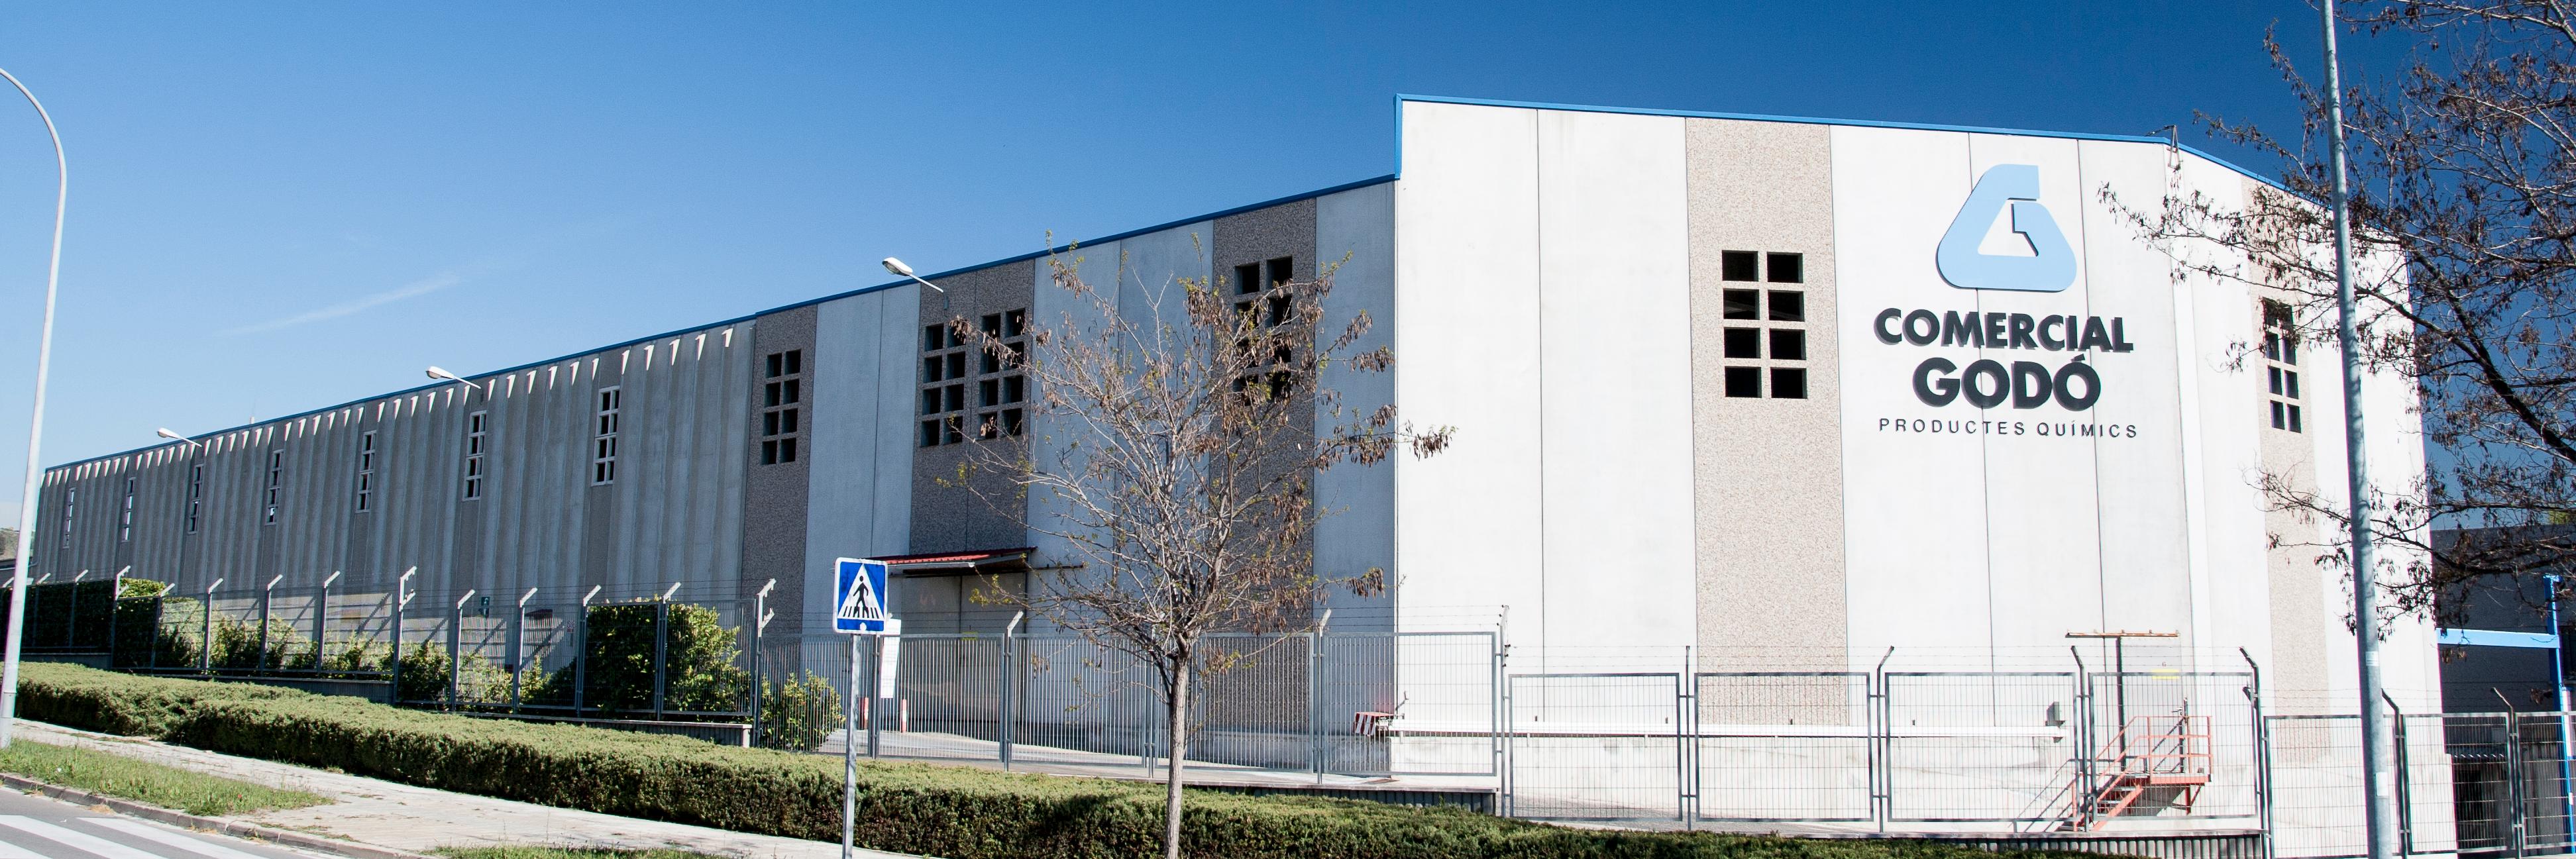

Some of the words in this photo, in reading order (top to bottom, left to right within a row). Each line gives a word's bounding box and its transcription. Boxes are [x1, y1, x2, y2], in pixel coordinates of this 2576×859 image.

[1874, 307, 2134, 353] COMERCIAL
[1913, 354, 2101, 411] GODÓ
[1879, 418, 2025, 435] PRODUCTES
[2037, 421, 2137, 438] QUÍMICS
